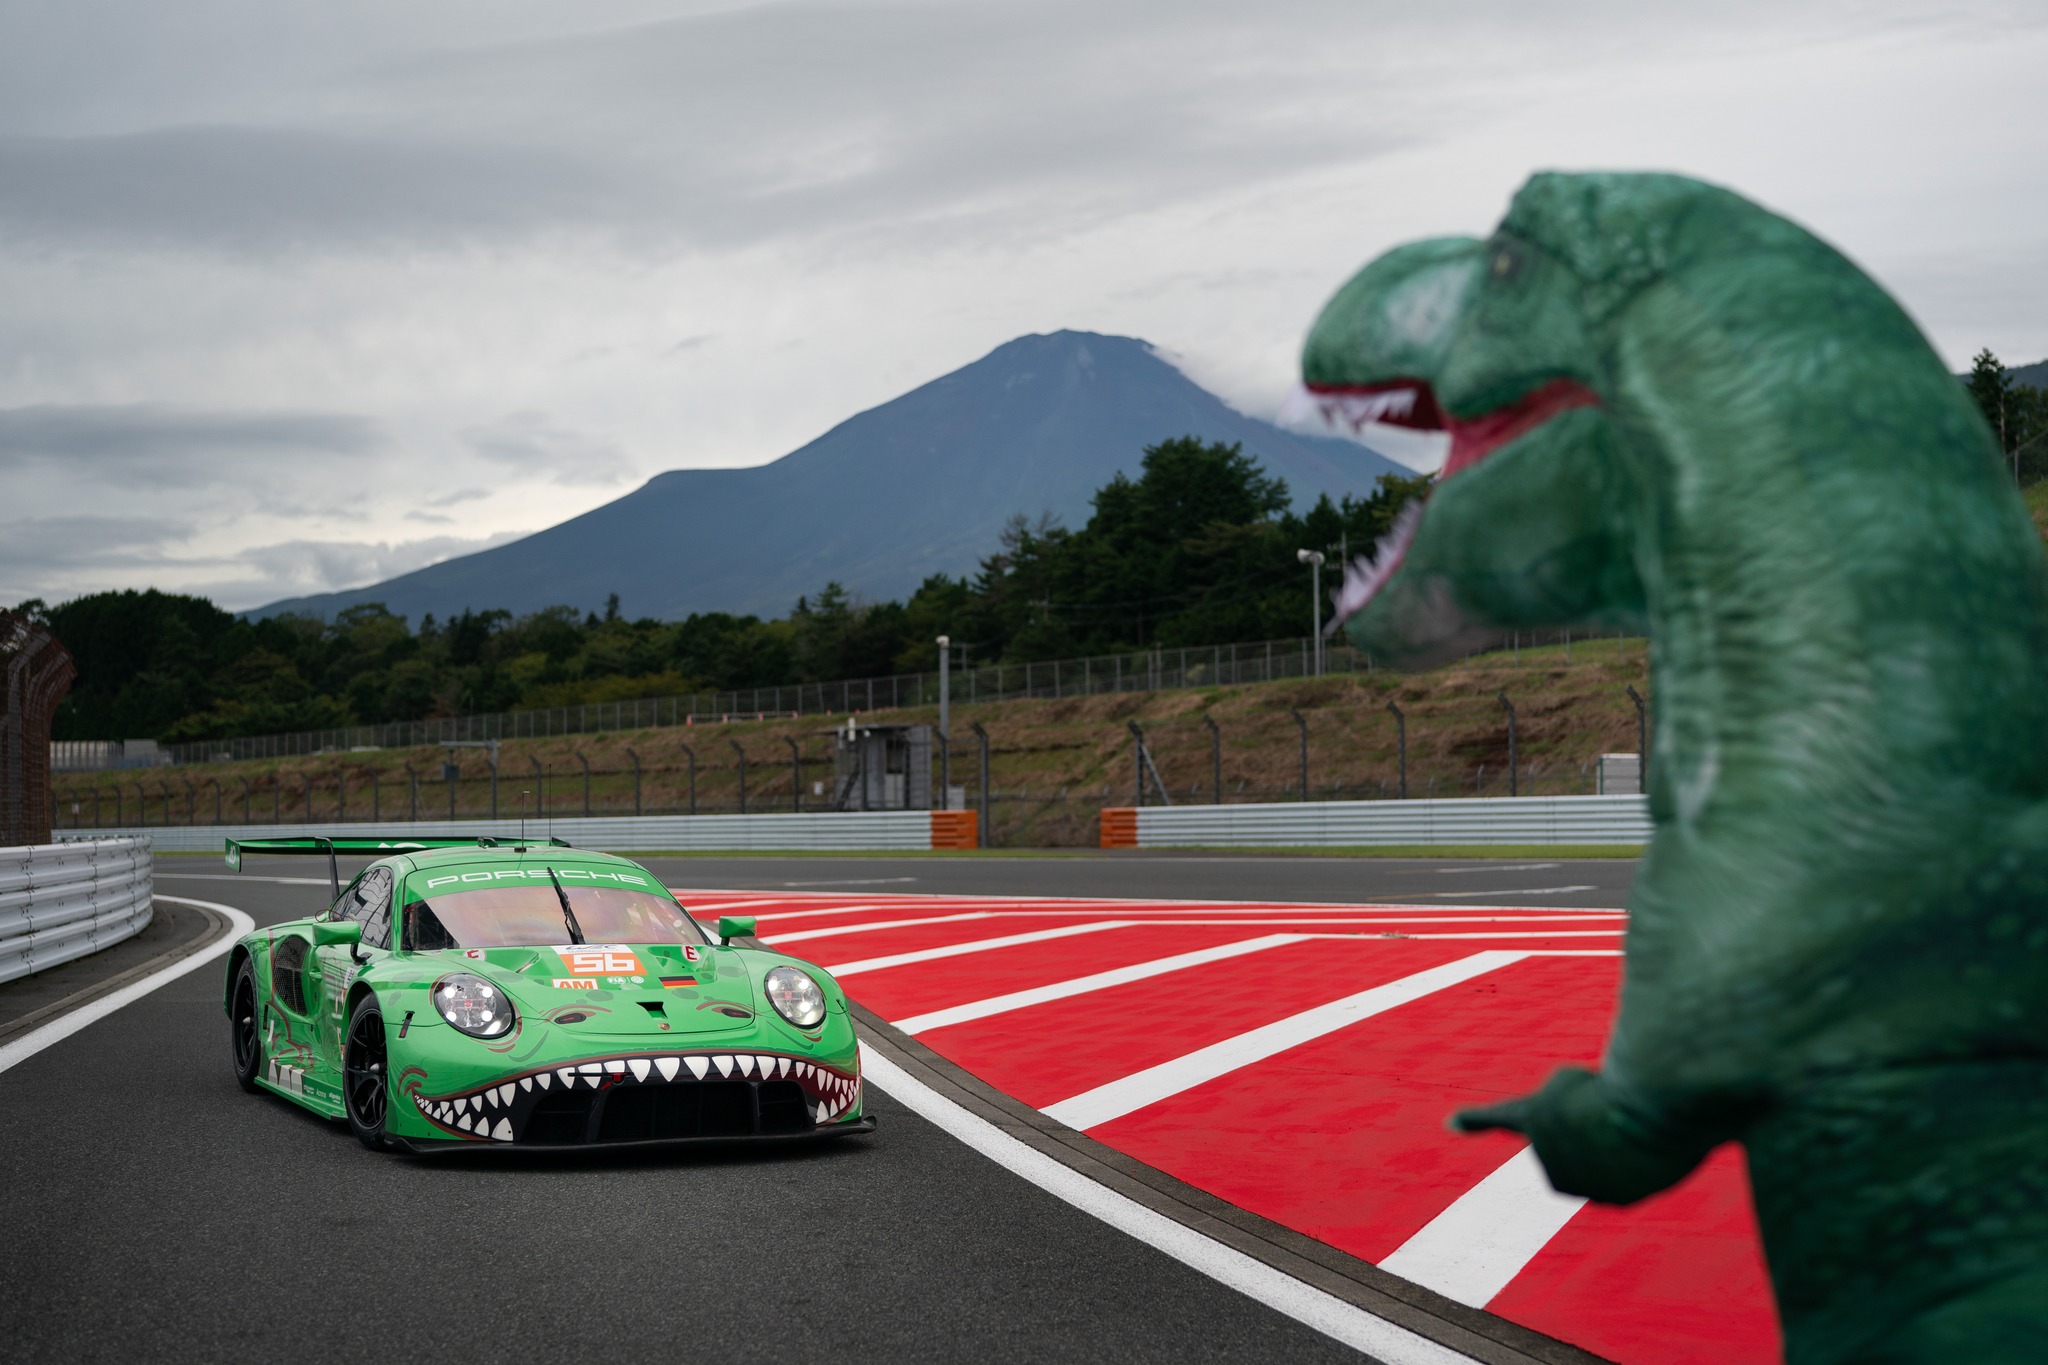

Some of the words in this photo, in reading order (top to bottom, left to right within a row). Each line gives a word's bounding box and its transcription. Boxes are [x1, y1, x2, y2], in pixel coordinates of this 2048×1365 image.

[427, 869, 648, 888] PORSCHE
[685, 945, 697, 960] E
[573, 954, 635, 972] 56
[559, 981, 594, 989] AM
